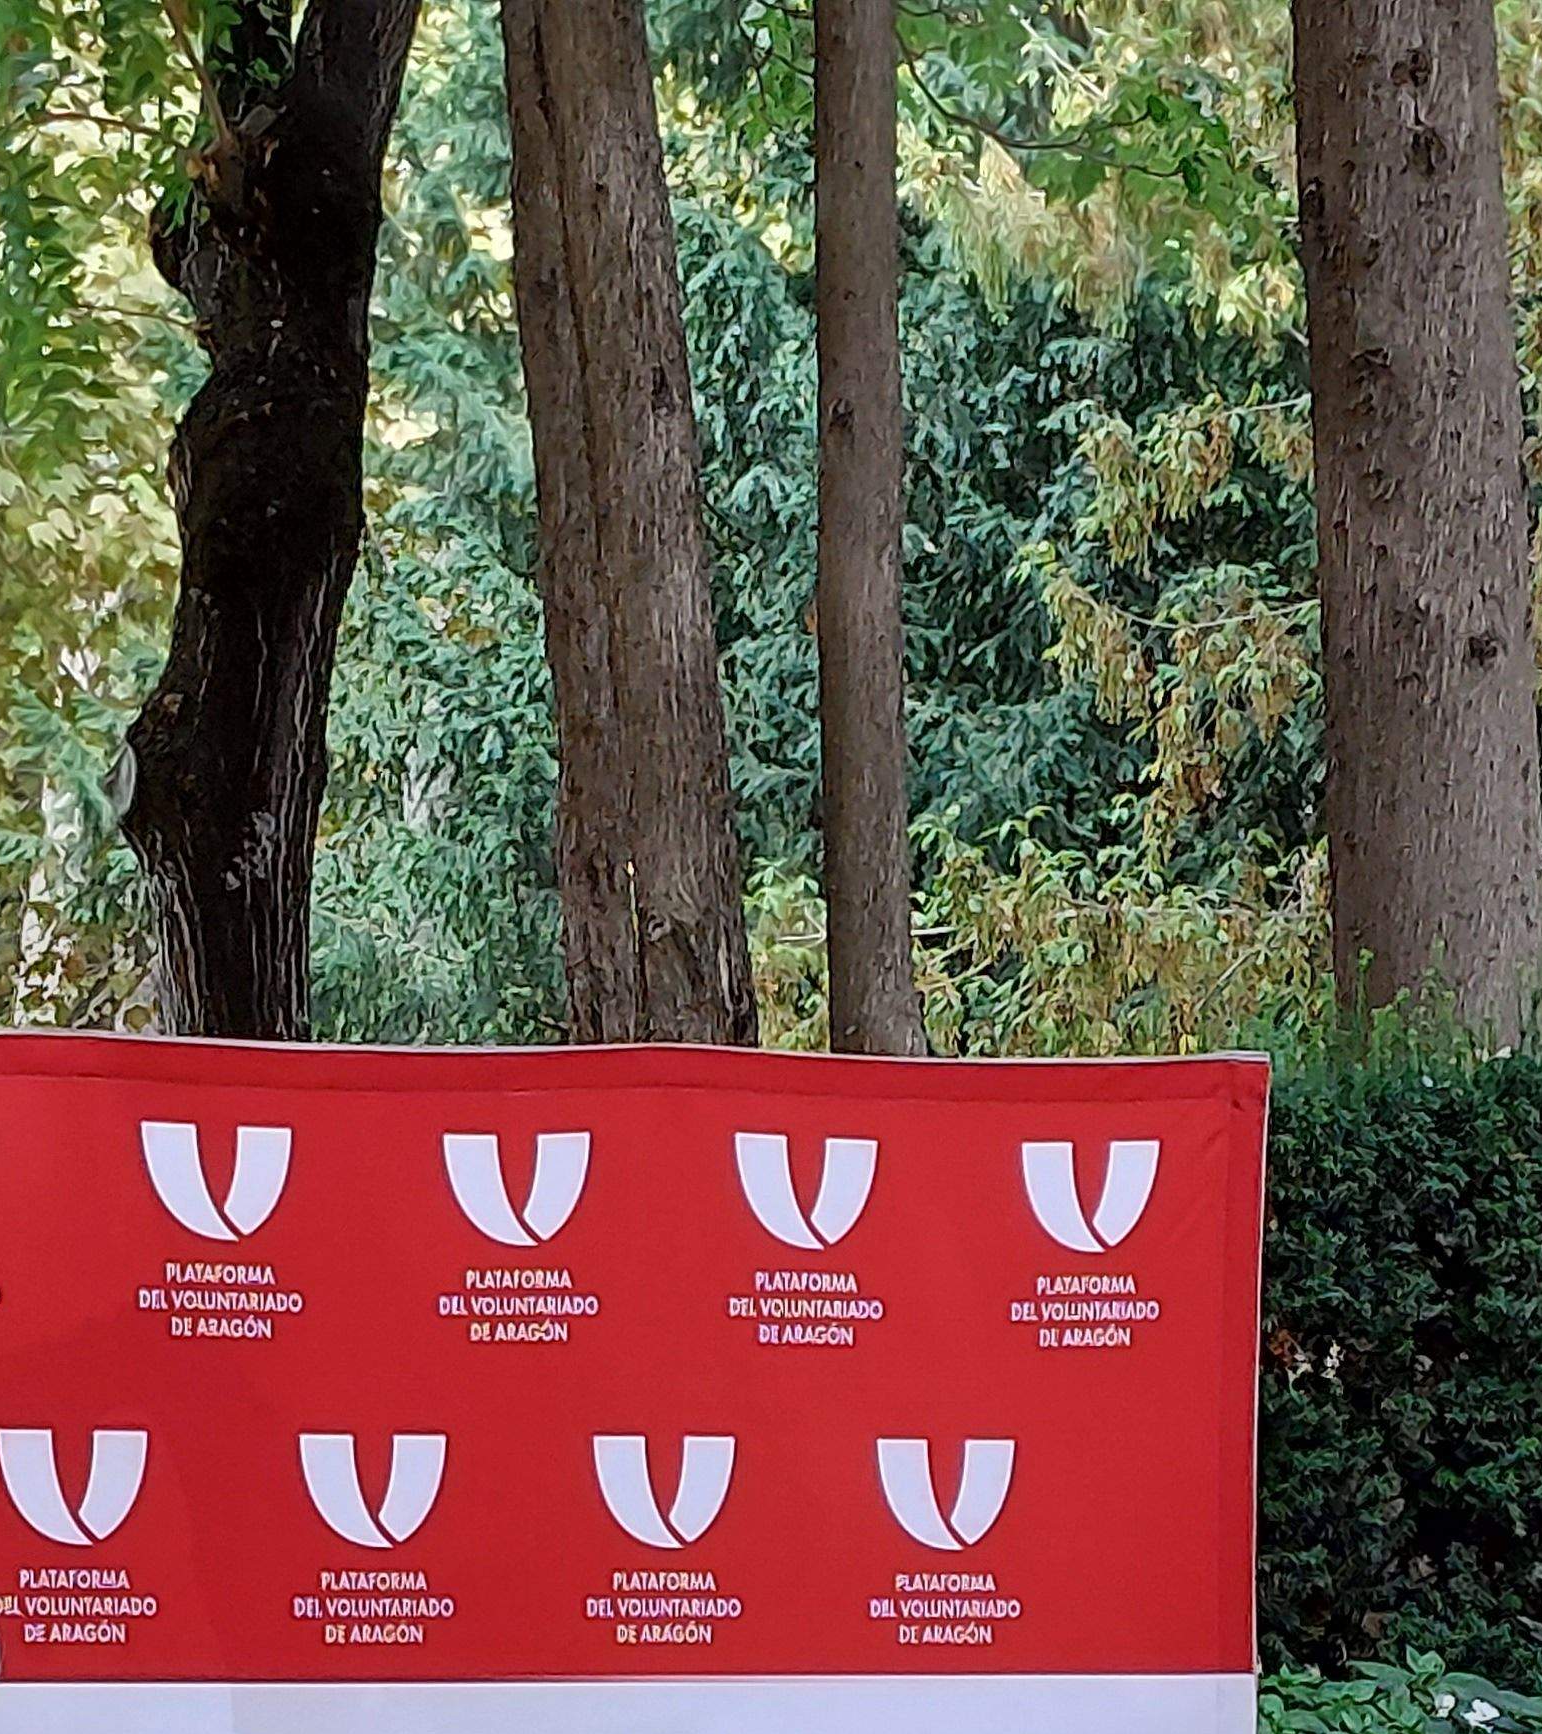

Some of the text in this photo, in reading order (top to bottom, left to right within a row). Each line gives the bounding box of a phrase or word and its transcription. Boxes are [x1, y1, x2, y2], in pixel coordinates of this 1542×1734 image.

[164, 1261, 277, 1286] PLATAFORMA
[464, 1267, 574, 1291] PLATAFORMA
[753, 1270, 859, 1295] PLATAFORMA
[1035, 1273, 1138, 1297] PLATAFORMA
[137, 1287, 304, 1314] DEL VOLUNTARIADO
[437, 1294, 600, 1317] DEL VOLUNTARIADO
[727, 1295, 885, 1321] DEL VOLUNTARIADO
[1009, 1299, 1161, 1324] DEL VOLUNTARIADO
[170, 1313, 273, 1340] DE ARAGÓN
[468, 1316, 569, 1343] DE ARAGÓN
[757, 1320, 855, 1347] DE ARAGÓN
[1060, 1321, 1132, 1348] ARAGÓN
[18, 1567, 132, 1591] PLATAFORMA
[319, 1569, 429, 1593] PLATAFORMA
[611, 1570, 718, 1593] PLATAFORMA
[893, 1571, 997, 1594] PLATAFORMA
[23, 1594, 158, 1618] VOLUNTARIADO
[291, 1595, 455, 1620] DEL VOLUNTARIADO
[585, 1596, 743, 1620] DEL VOLUNTARIADO
[898, 1597, 1022, 1620] VOLUNTARIADO
[23, 1617, 127, 1644] DE ARAGÓN
[323, 1621, 425, 1645] DE ARAGÓN
[615, 1619, 713, 1645] DE ARAGÓN
[897, 1619, 994, 1645] DE ARAGÓN
